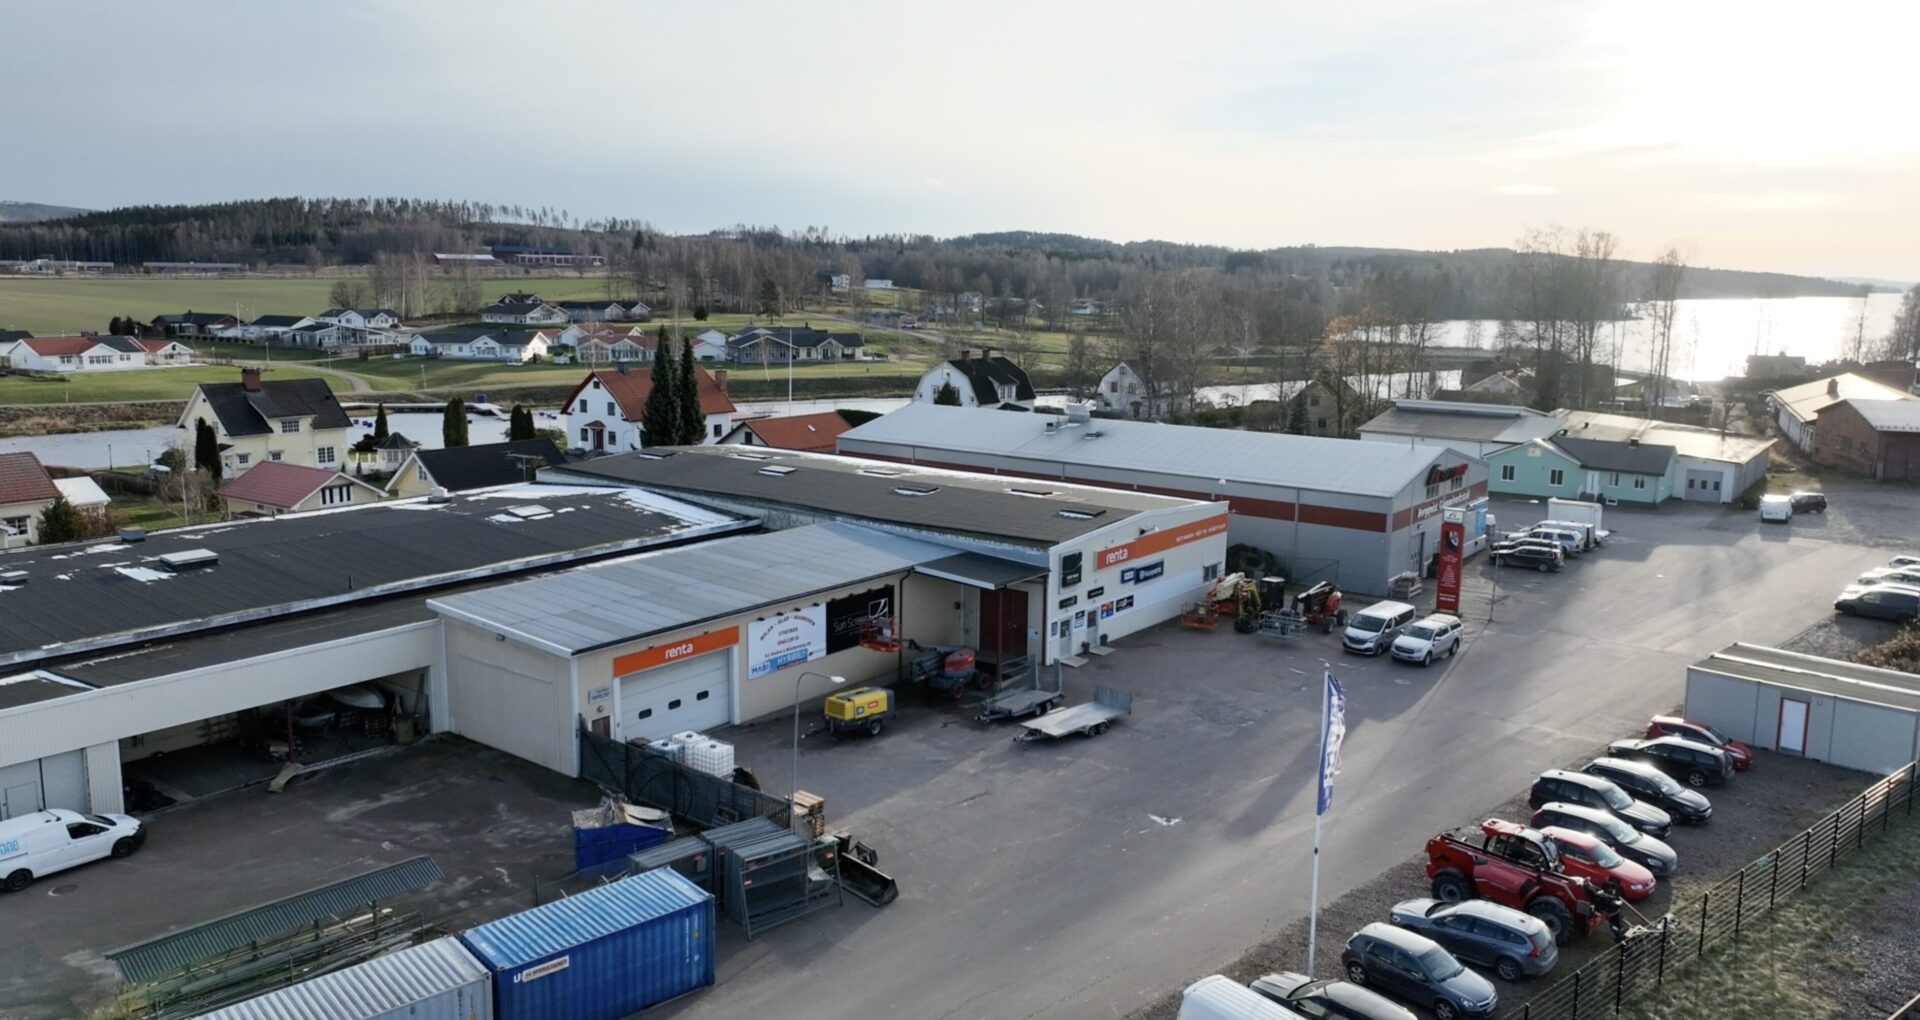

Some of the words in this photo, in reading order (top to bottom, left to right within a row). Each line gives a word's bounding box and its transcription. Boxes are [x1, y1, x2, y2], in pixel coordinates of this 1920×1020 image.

[1105, 547, 1128, 565] renta
[833, 620, 847, 634] Sun
[665, 643, 693, 660] renta
